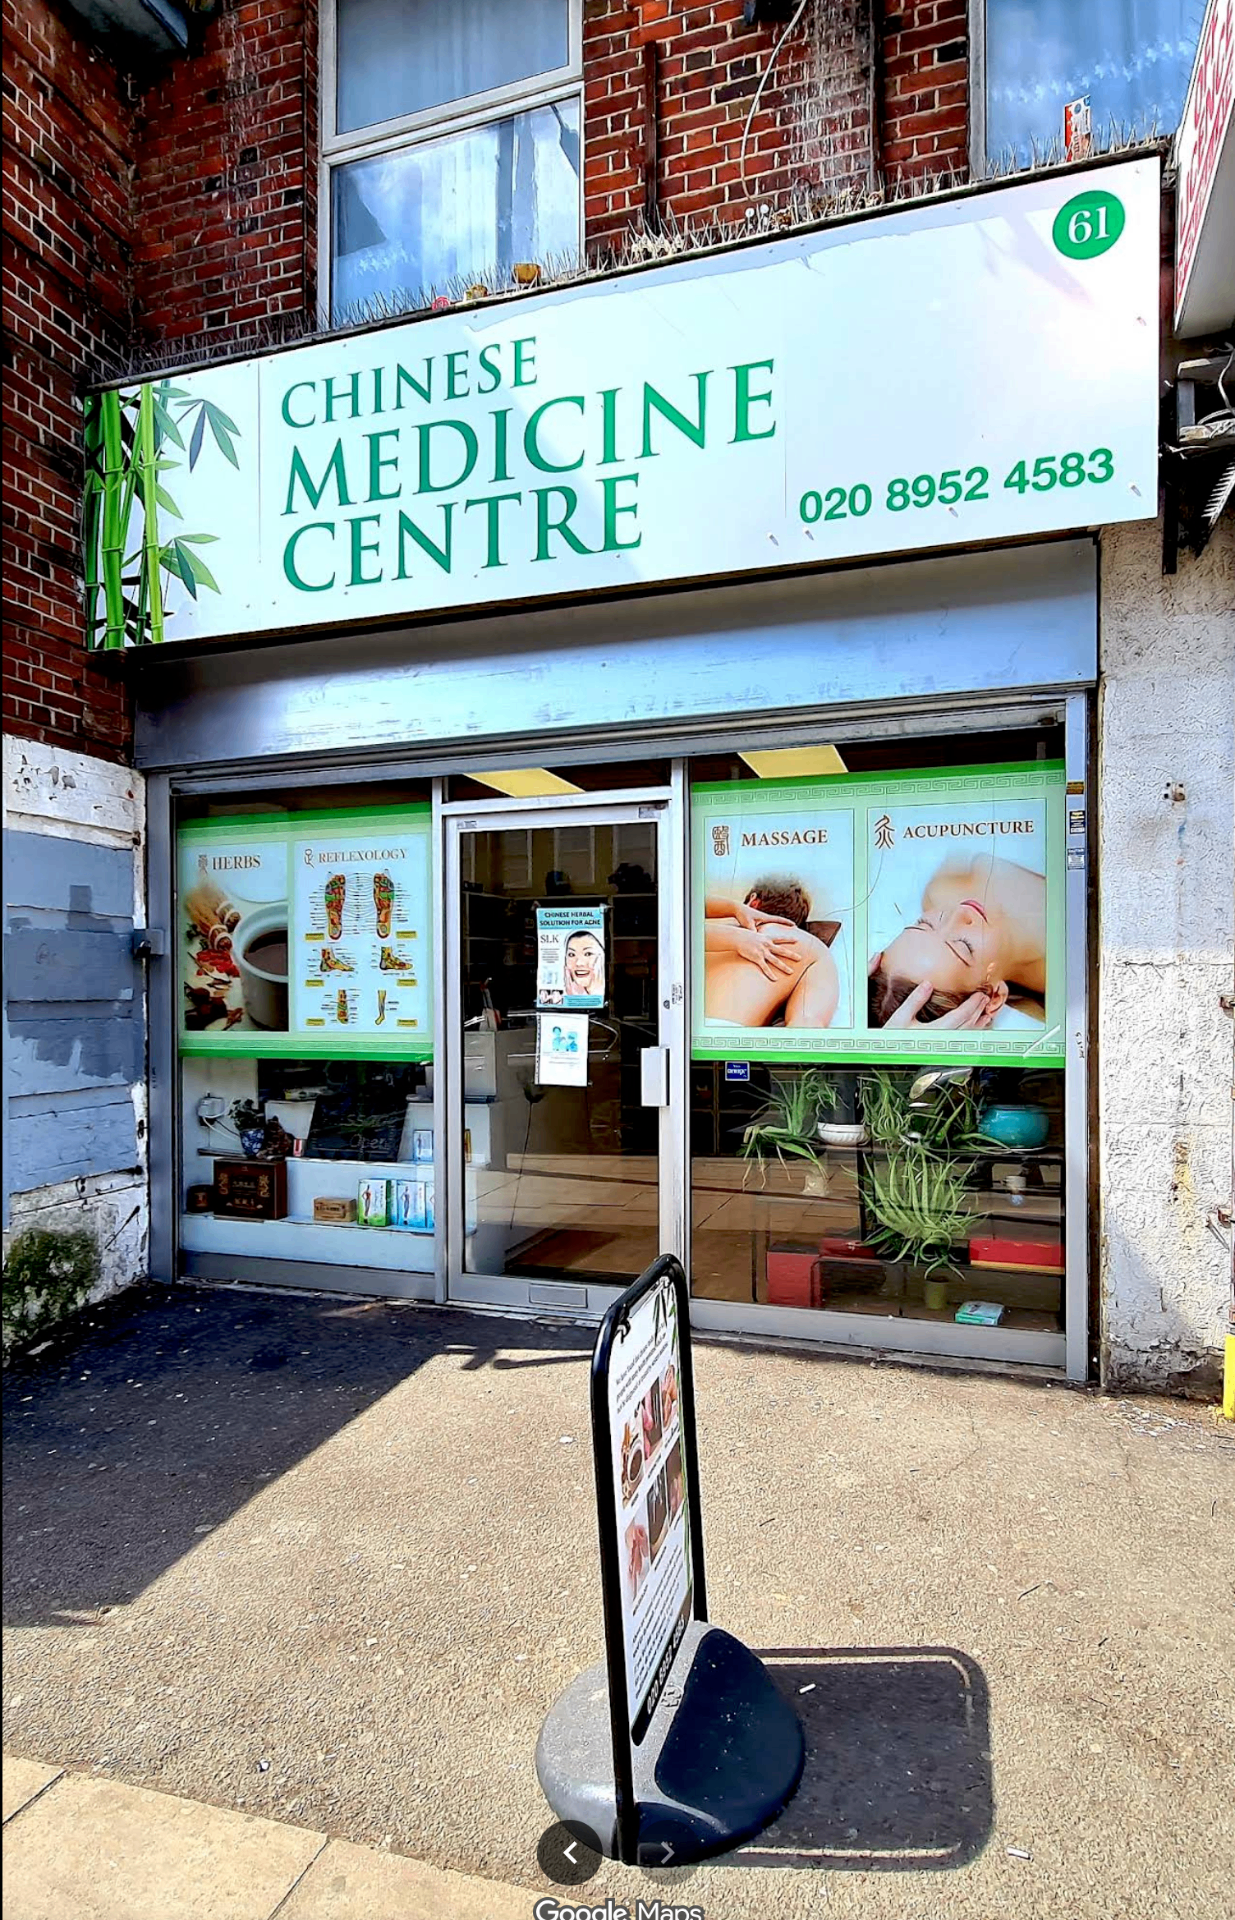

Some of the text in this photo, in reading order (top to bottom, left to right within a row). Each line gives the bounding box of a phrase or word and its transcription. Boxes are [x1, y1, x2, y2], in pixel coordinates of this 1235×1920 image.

[1068, 206, 1111, 244] 61
[281, 336, 538, 429] CHINESE
[280, 358, 777, 516] MEDICINE
[799, 447, 1114, 523] 020 8952 4583
[283, 472, 642, 592] CENTRE
[741, 829, 828, 847] MASSAGE
[903, 820, 1034, 839] ACUPUNCTURE
[212, 854, 261, 870] HERBS
[318, 848, 407, 864] REFLEXOLOGY
[539, 919, 571, 927] SOLUTION
[584, 918, 601, 926] ACNE
[540, 934, 559, 944] SLK
